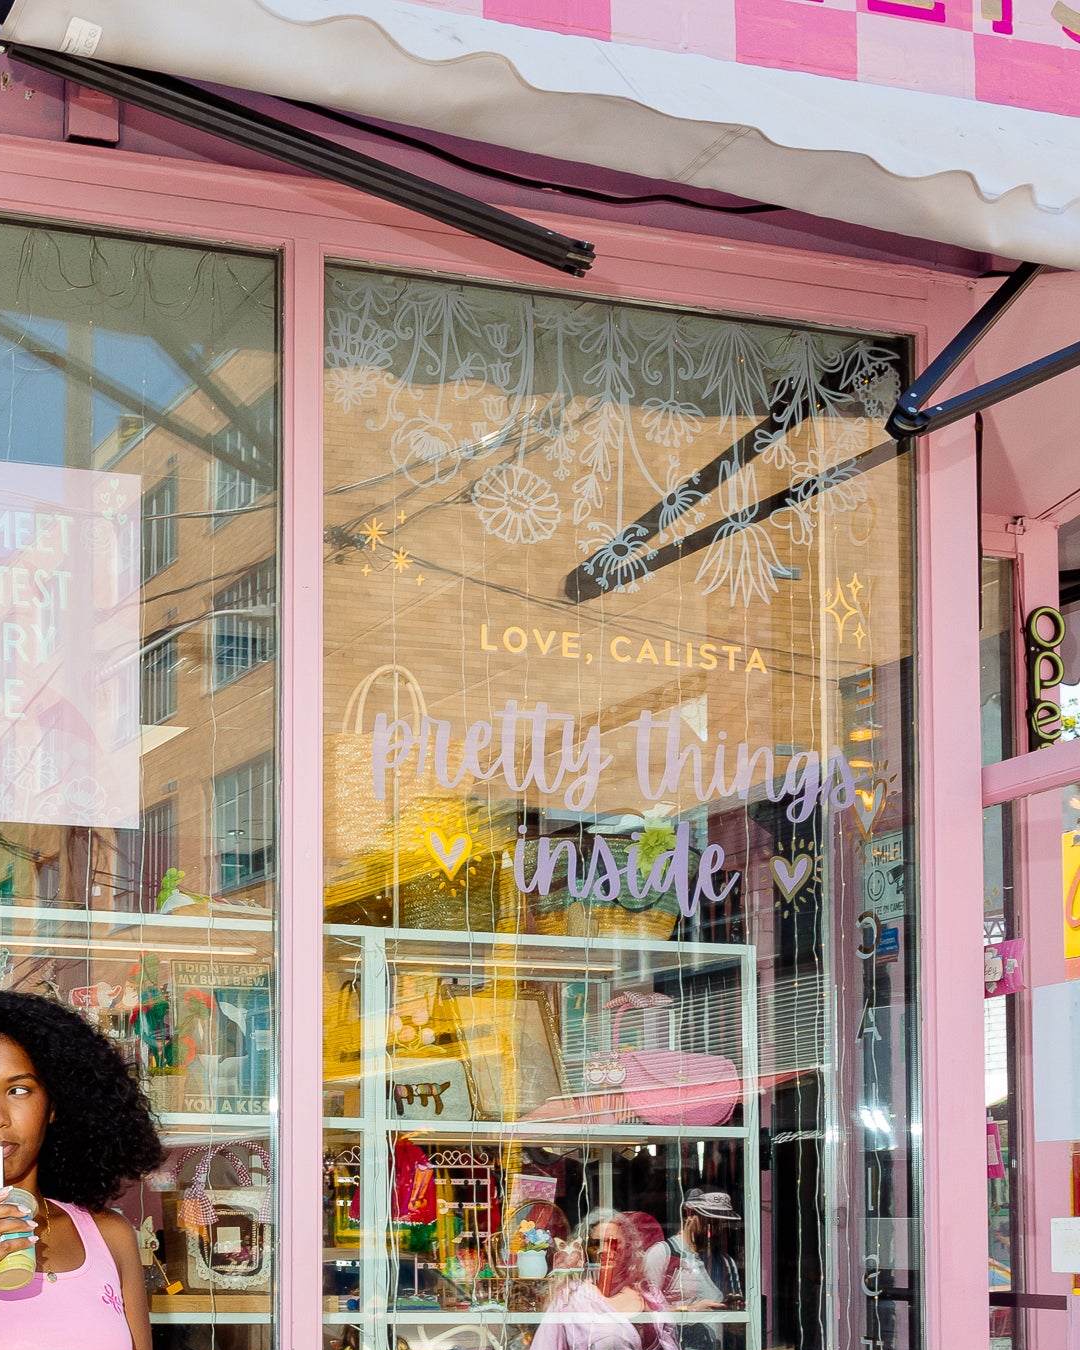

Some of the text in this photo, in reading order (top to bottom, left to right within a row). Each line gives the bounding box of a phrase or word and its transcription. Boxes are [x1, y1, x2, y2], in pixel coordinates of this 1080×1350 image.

[480, 623, 768, 674] LOVE, CALISTA
[371, 699, 868, 824] pretty things
[514, 823, 740, 918] inside
[178, 975, 265, 987] MY BUTT BLEW
[185, 963, 229, 974] DIDN'T
[232, 966, 265, 975] FART
[184, 1098, 271, 1114] YOU A KISS
